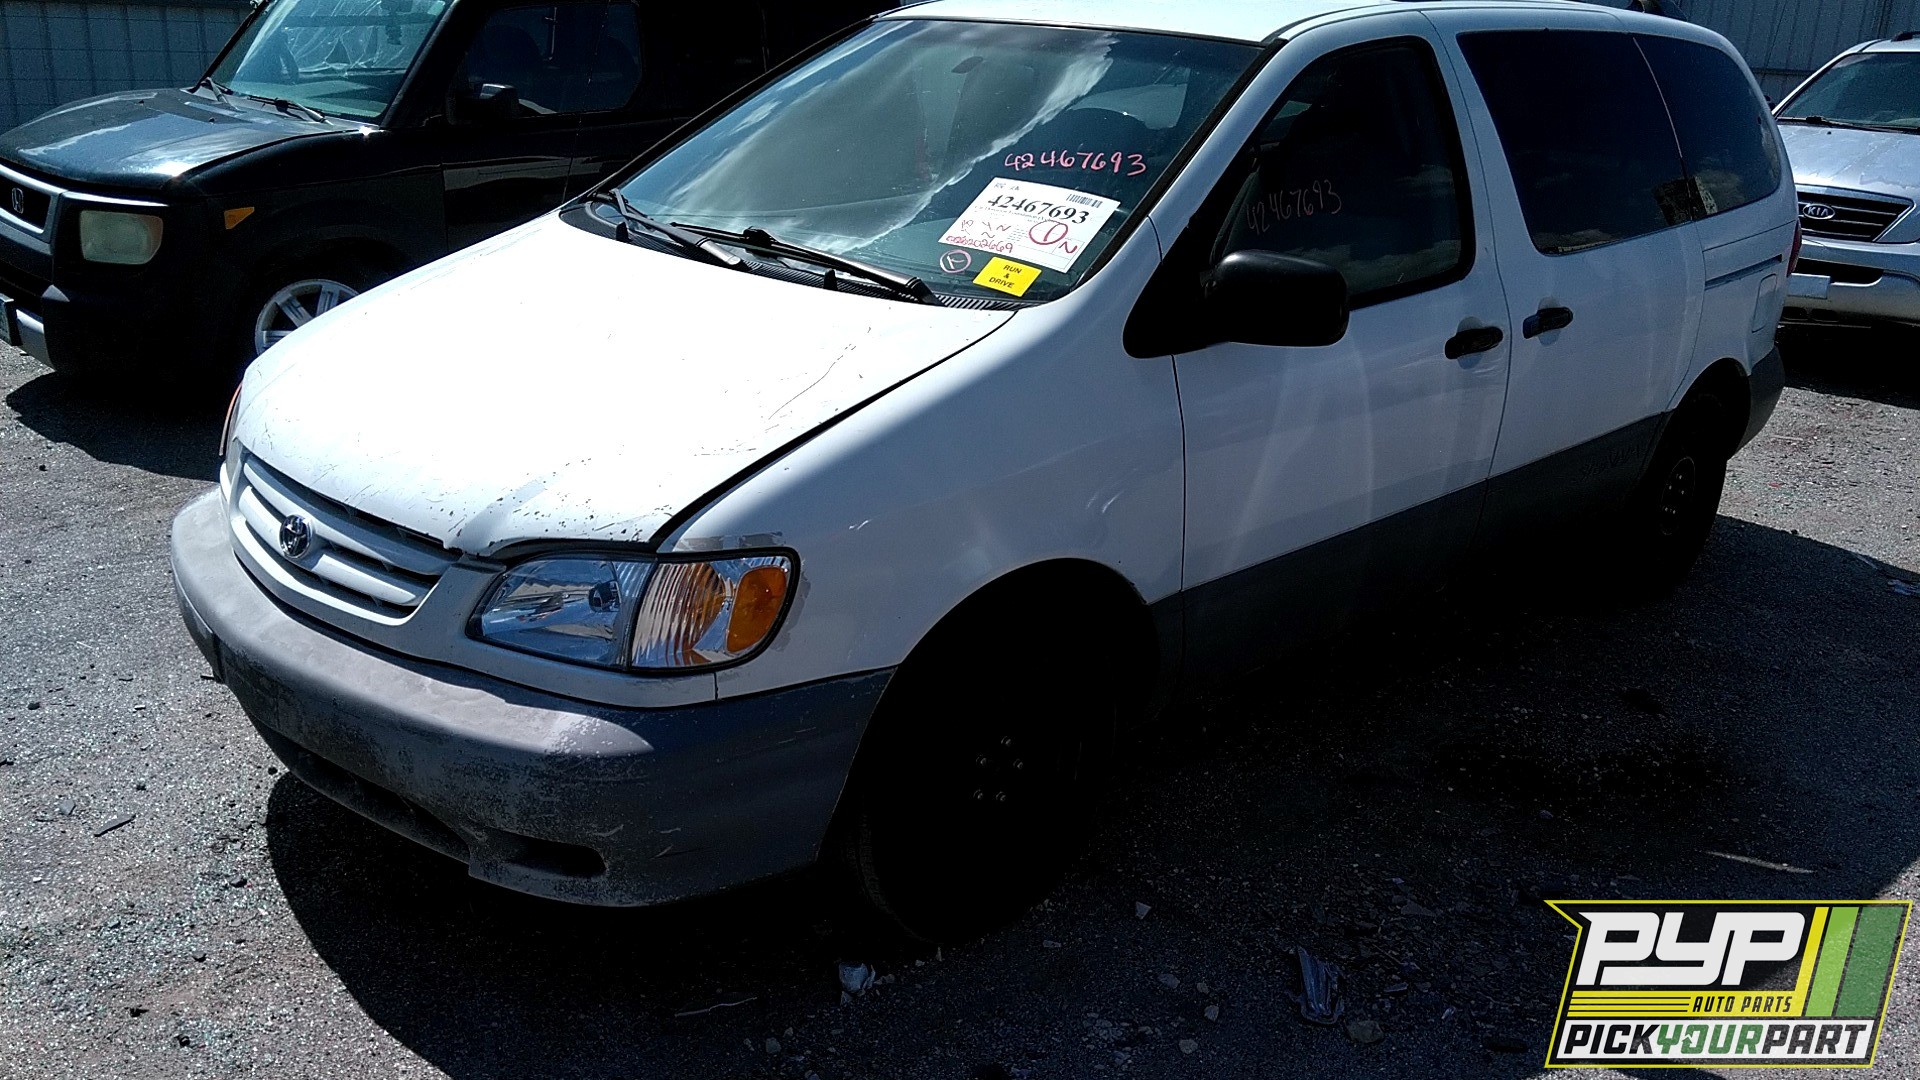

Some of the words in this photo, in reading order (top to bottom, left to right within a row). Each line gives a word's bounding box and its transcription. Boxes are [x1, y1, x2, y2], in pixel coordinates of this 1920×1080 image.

[1004, 150, 1147, 176] 42467693
[987, 194, 1089, 224] 42467693
[1246, 179, 1342, 236] 42467693
[1807, 206, 1829, 217] KIA
[1003, 264, 1023, 274] RUN
[989, 277, 1015, 288] DRIVE
